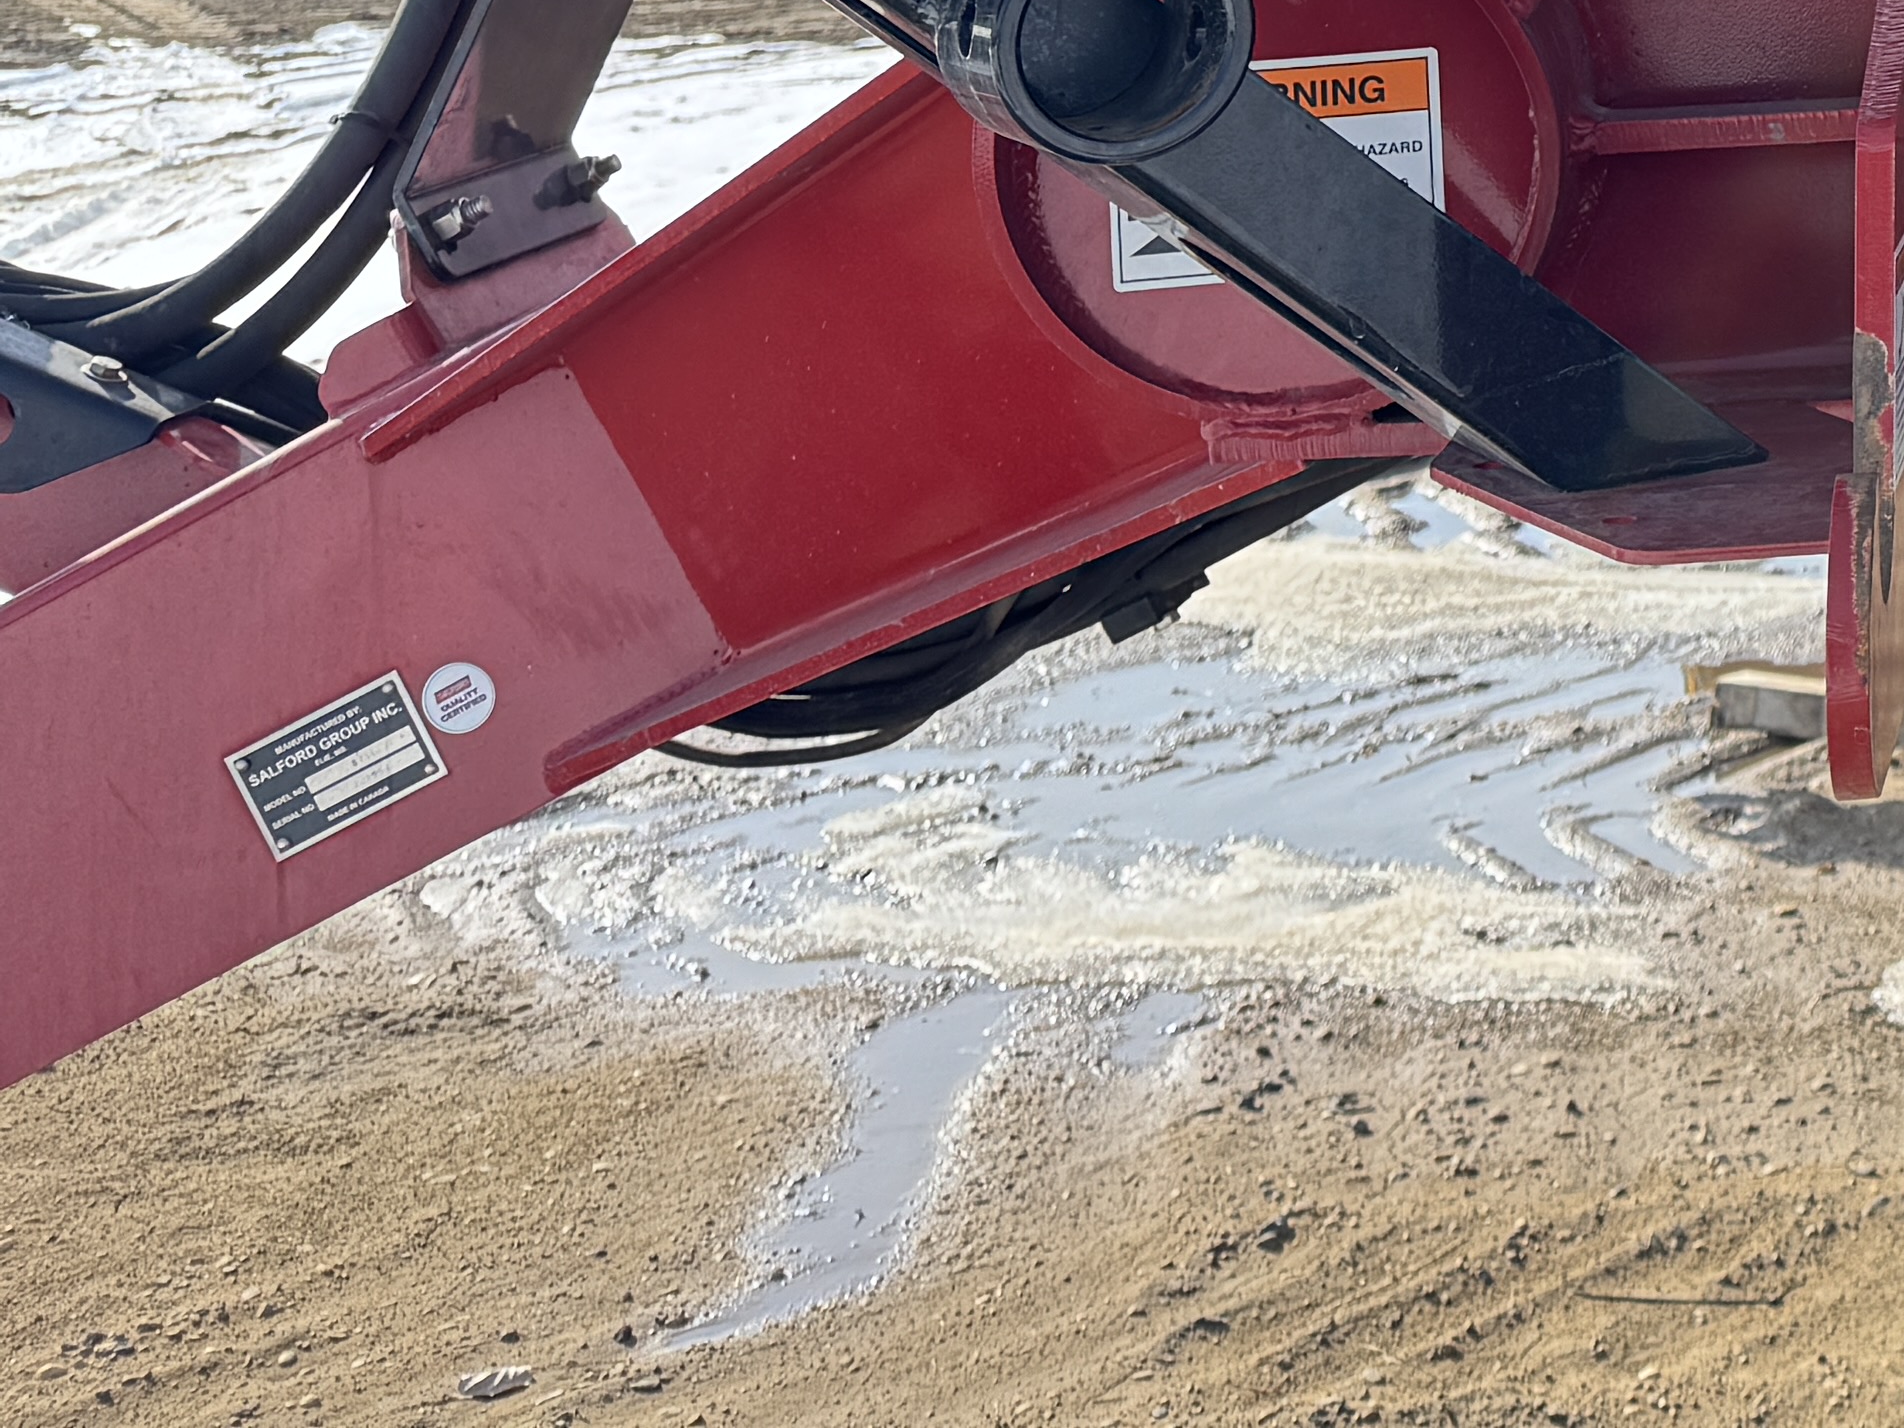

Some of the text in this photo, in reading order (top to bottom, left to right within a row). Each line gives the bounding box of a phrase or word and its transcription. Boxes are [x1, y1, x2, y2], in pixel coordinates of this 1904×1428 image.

[1270, 75, 1385, 108] NING
[439, 692, 488, 723] CERTIFIED
[440, 686, 480, 713] QUALITY
[246, 742, 319, 788] SALFORD
[317, 715, 373, 751] GROUP
[370, 699, 403, 724] INC.
[273, 712, 346, 756] MANUFACTURED
[262, 792, 293, 812] MODEL
[325, 784, 390, 822] MADE IN CANADA
[270, 809, 302, 830] SERIAL
